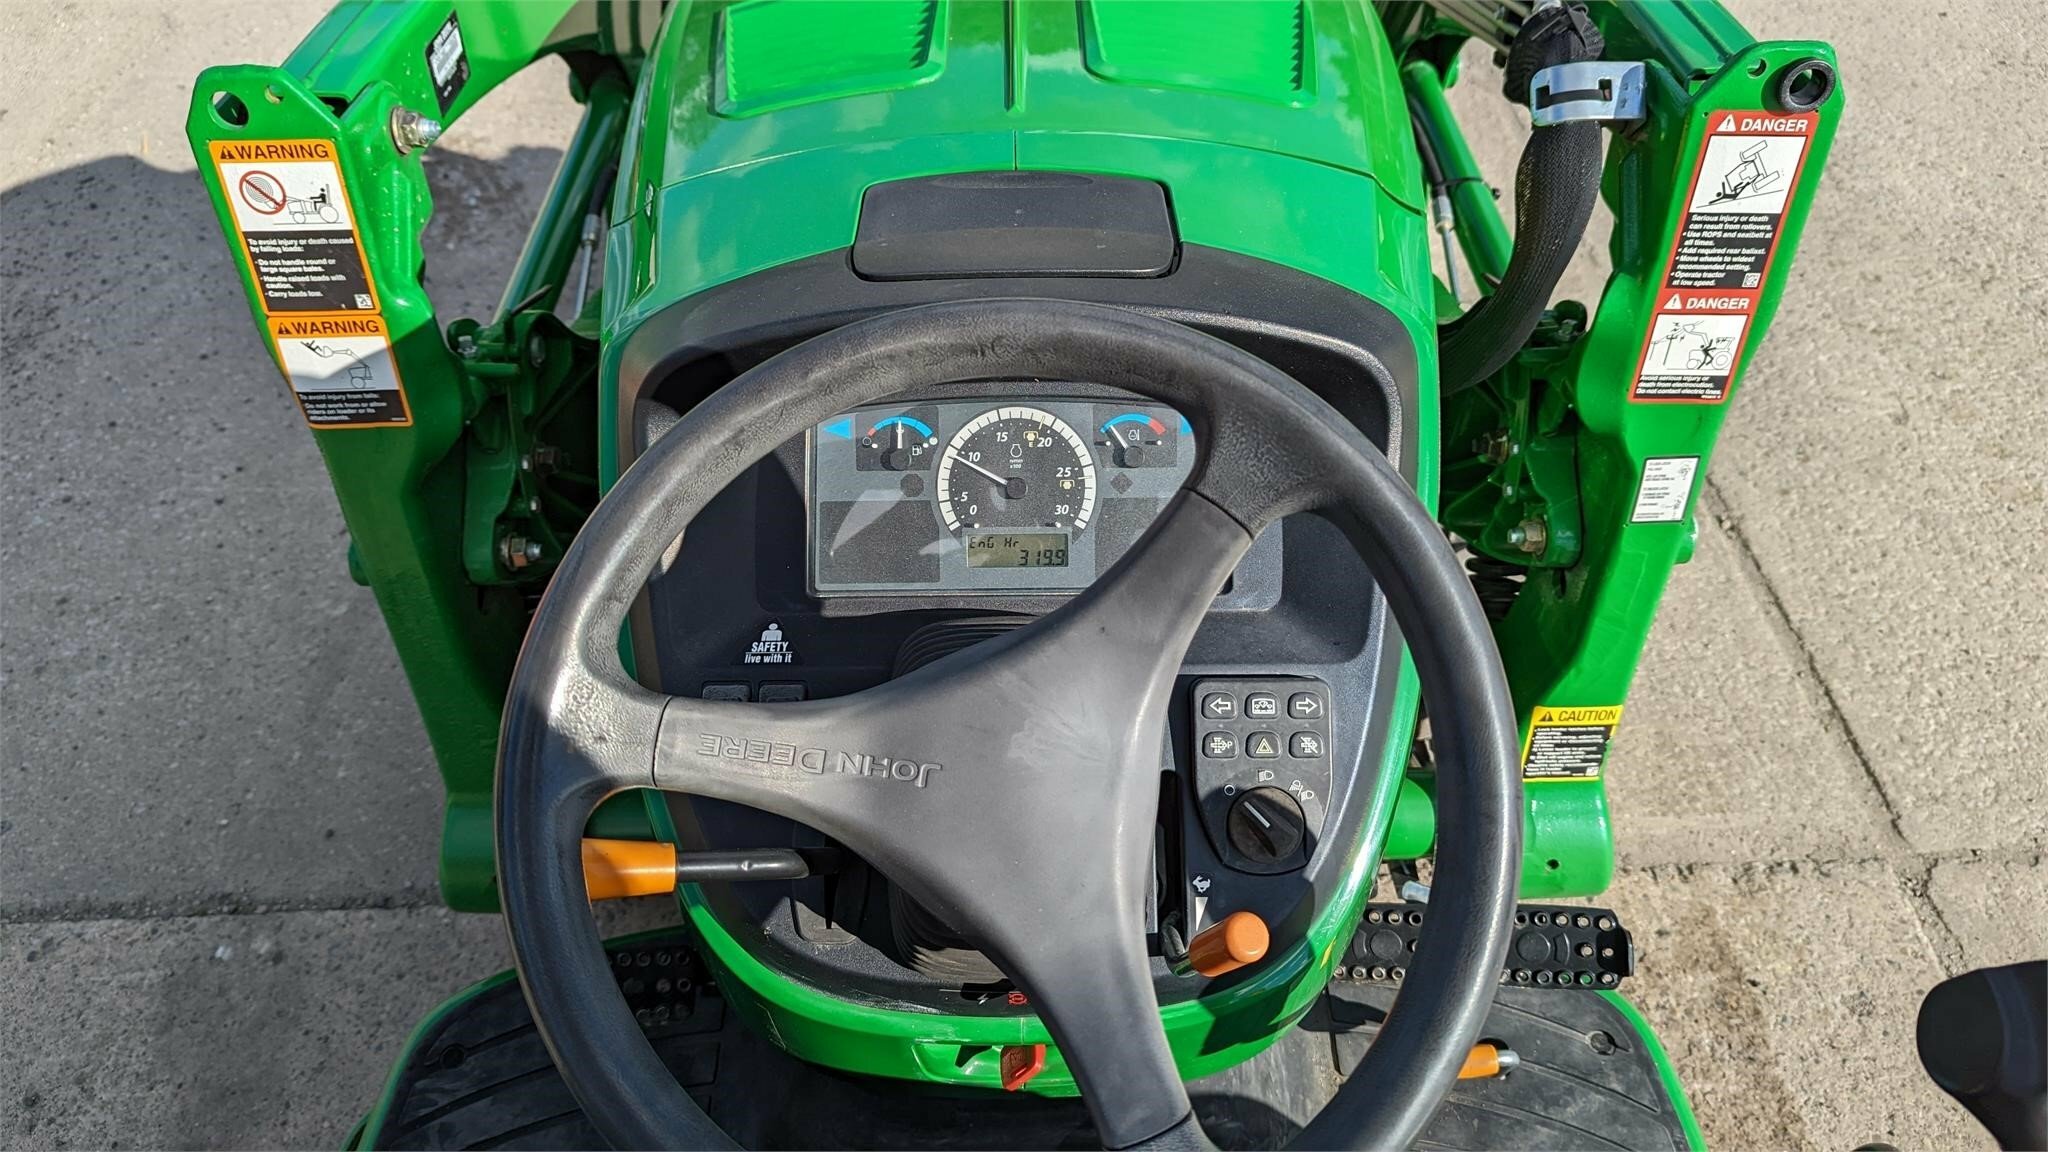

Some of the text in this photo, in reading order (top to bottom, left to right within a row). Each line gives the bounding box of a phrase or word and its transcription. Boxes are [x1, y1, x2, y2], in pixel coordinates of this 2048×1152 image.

[1741, 119, 1808, 132] DANGER
[234, 144, 328, 159] WARNING
[278, 239, 298, 247] injury
[1686, 298, 1750, 309] DANGER
[291, 320, 379, 335] WARNING
[996, 432, 1008, 442] 15
[1037, 437, 1052, 447] 20
[969, 452, 980, 462] 10
[1056, 467, 1071, 477] 25
[960, 492, 968, 501] 5
[970, 505, 977, 514] 0
[1054, 504, 1069, 514] 30
[1004, 537, 1019, 548] Hr
[1019, 549, 1066, 566] 319.9
[751, 642, 789, 652] SAFETY
[744, 654, 792, 663] live with it
[1558, 710, 1617, 721] CAUTION
[698, 732, 942, 788] JOHN DEERE
